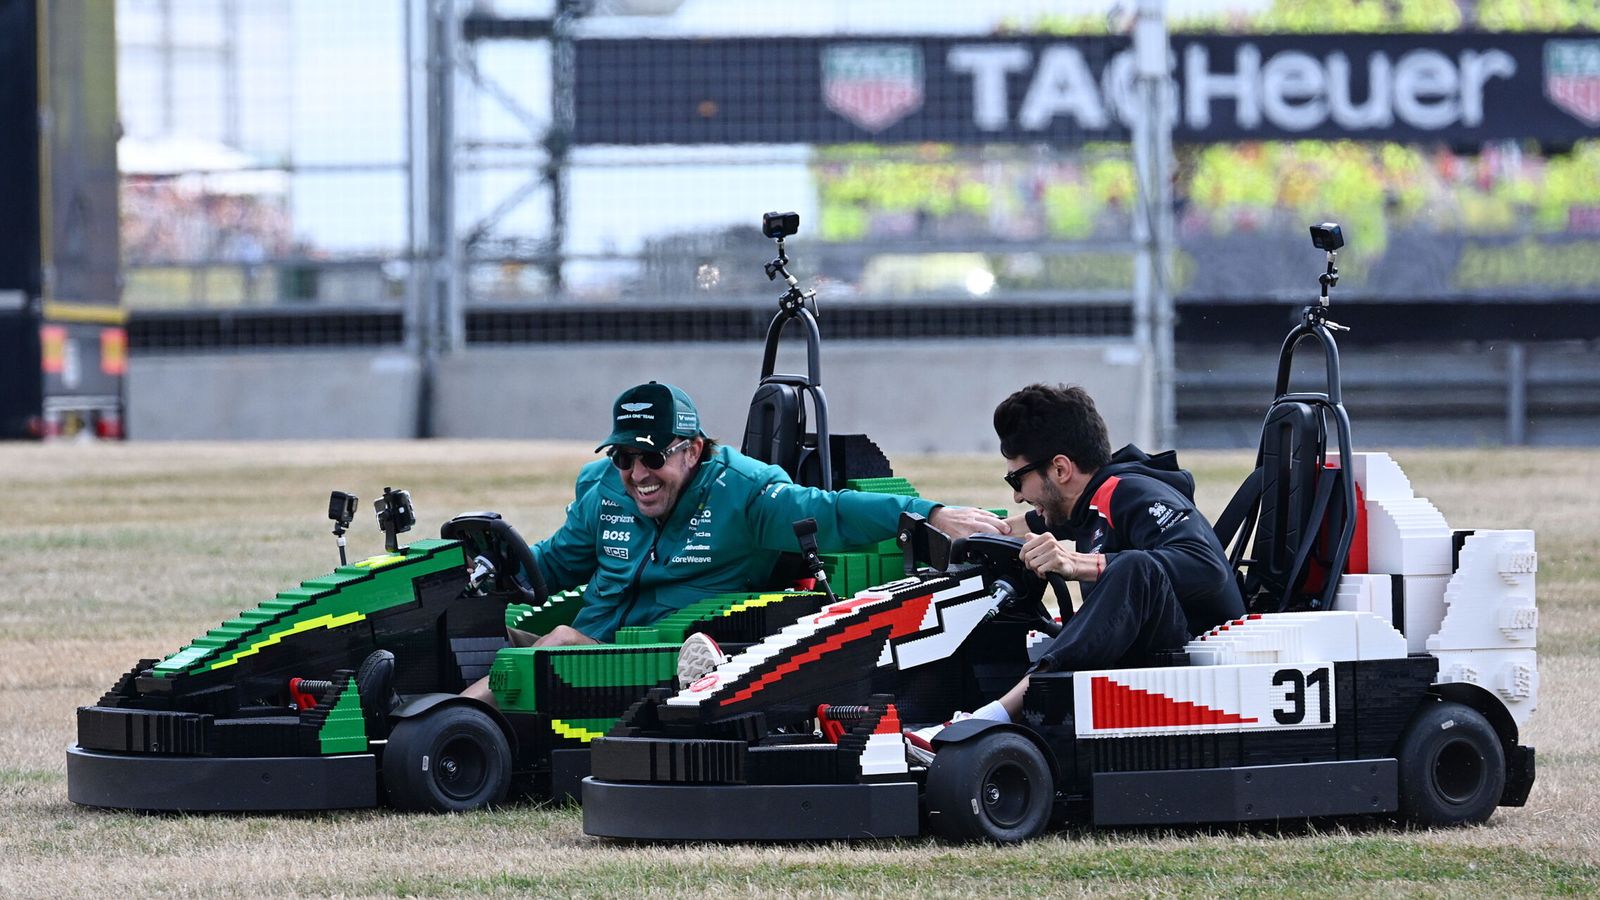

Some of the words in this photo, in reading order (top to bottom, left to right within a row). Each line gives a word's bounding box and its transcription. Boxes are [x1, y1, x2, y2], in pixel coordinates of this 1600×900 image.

[602, 530, 630, 541] BOSS
[604, 547, 628, 559] JCB
[1272, 667, 1331, 725] 31
